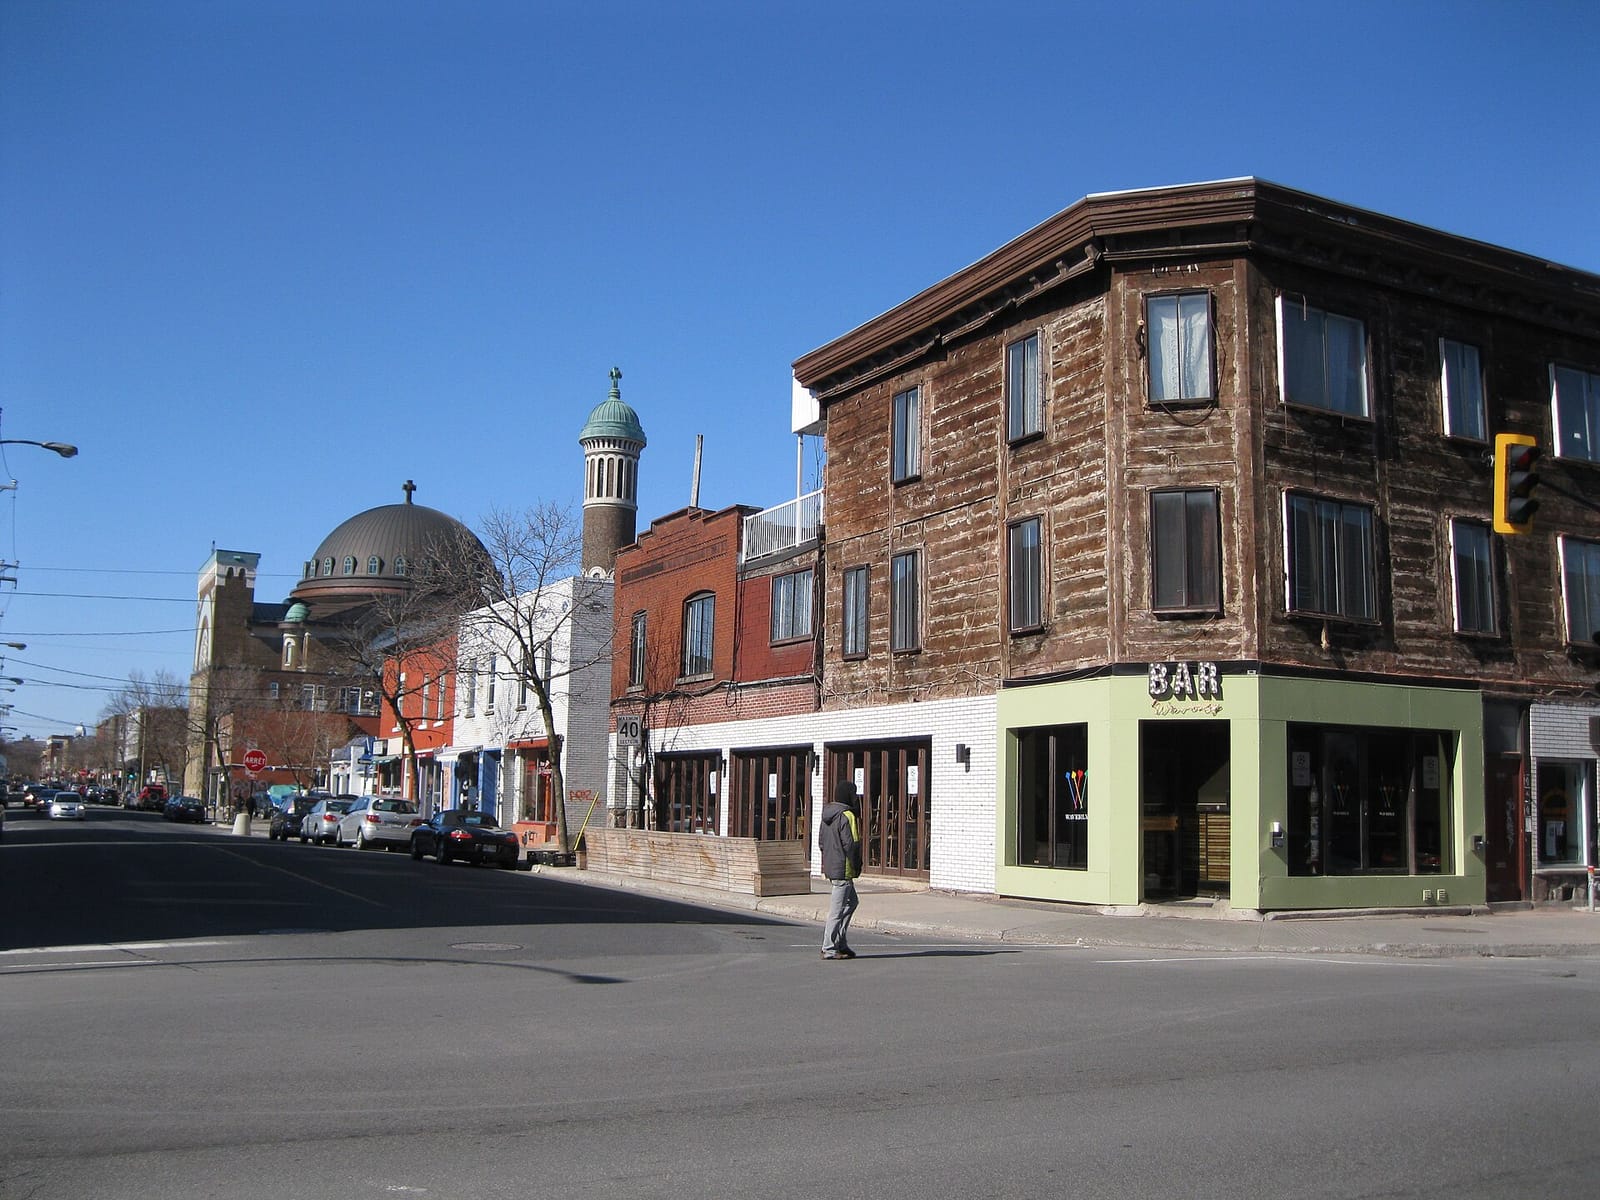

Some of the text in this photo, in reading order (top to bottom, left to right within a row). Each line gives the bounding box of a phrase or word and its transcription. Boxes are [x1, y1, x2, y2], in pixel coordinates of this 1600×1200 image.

[1148, 661, 1221, 697] BAR
[620, 722, 639, 738] 40
[246, 756, 266, 765] ARRÊT
